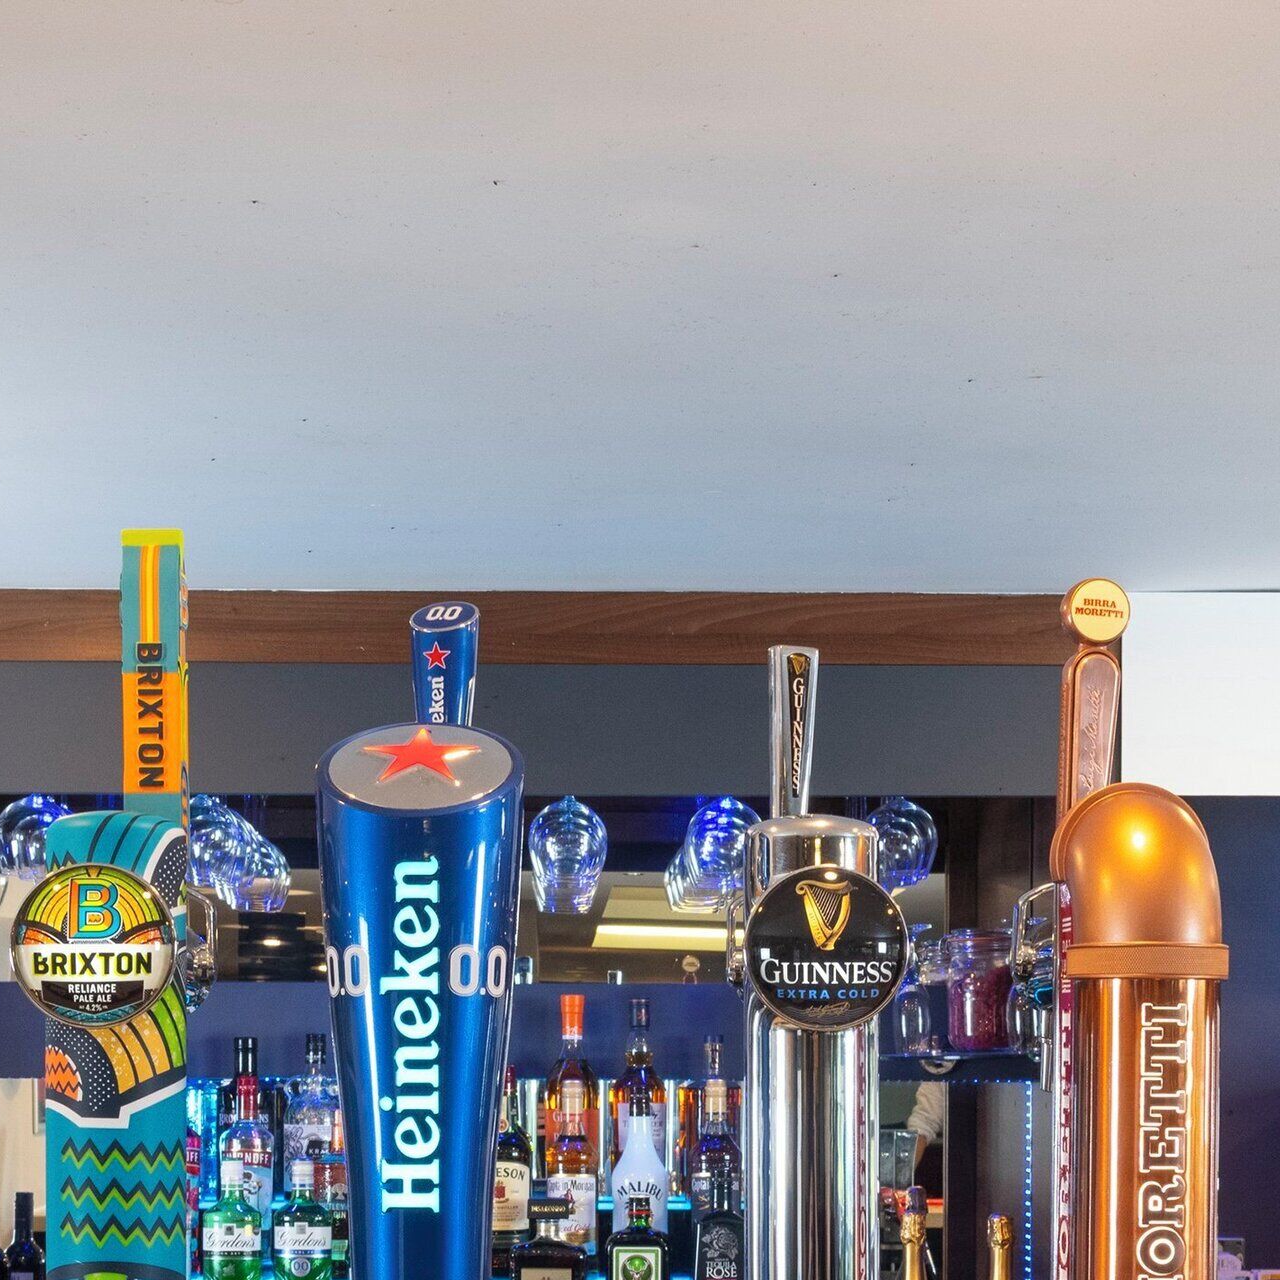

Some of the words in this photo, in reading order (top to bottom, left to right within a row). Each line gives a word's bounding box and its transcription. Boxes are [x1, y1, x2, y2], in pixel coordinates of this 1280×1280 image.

[1083, 598, 1117, 608] BIRRA
[426, 606, 463, 622] 0.0
[1075, 607, 1124, 619] MORETTI
[428, 675, 445, 723] eken
[136, 642, 165, 788] BRIXTON
[792, 677, 804, 790] GUINNESS
[33, 952, 152, 975] BRIXTON
[327, 944, 370, 998] 0.0
[448, 944, 507, 998] 0.0
[760, 958, 892, 985] GUINNESS
[68, 984, 116, 993] RELIANCE
[777, 989, 830, 999] EXTRA
[837, 988, 880, 999] COLD
[74, 994, 94, 1002] PALE
[97, 994, 112, 1002] ALE
[379, 855, 441, 1213] Heineken
[496, 1168, 525, 1181] ESON
[617, 1181, 664, 1200] MALIBU
[706, 1261, 737, 1269] TEQUILA
[706, 1267, 737, 1279] ROSE
